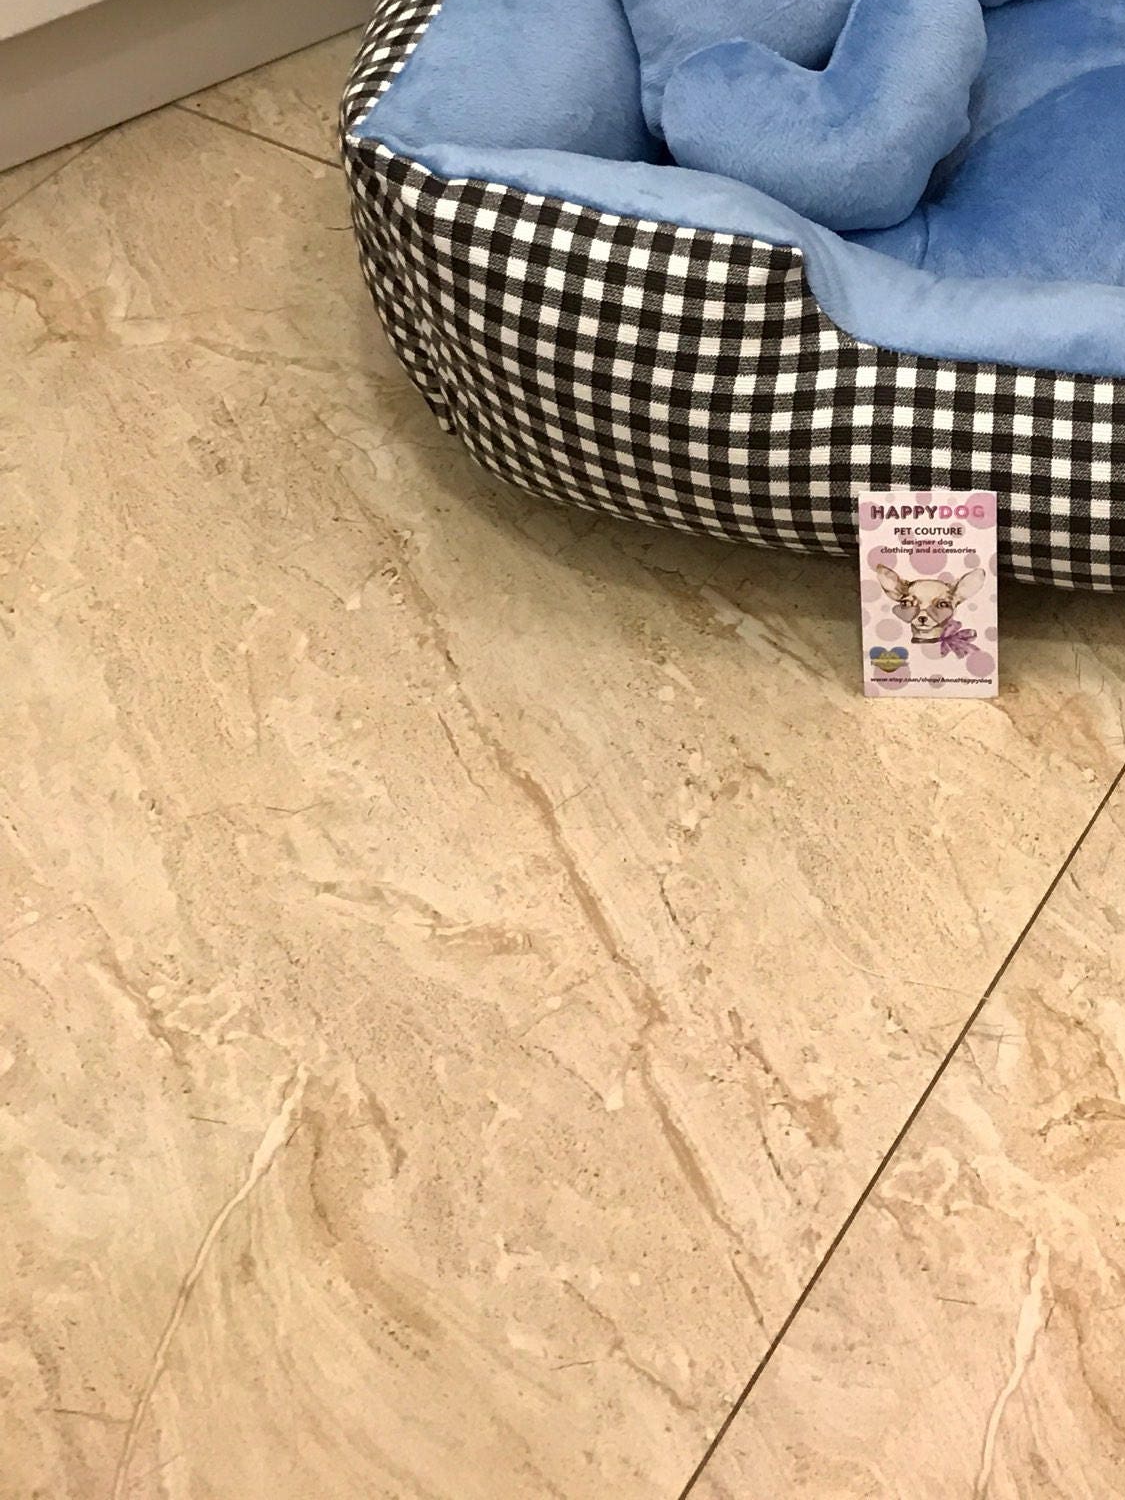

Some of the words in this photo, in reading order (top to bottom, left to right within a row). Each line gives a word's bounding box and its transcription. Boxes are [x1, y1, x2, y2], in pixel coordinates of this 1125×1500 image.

[894, 527, 912, 535] PET
[914, 527, 963, 536] COUTURE
[901, 538, 936, 547] designer
[937, 538, 954, 547] dog
[880, 547, 914, 555] clothing
[932, 546, 977, 554] accessories
